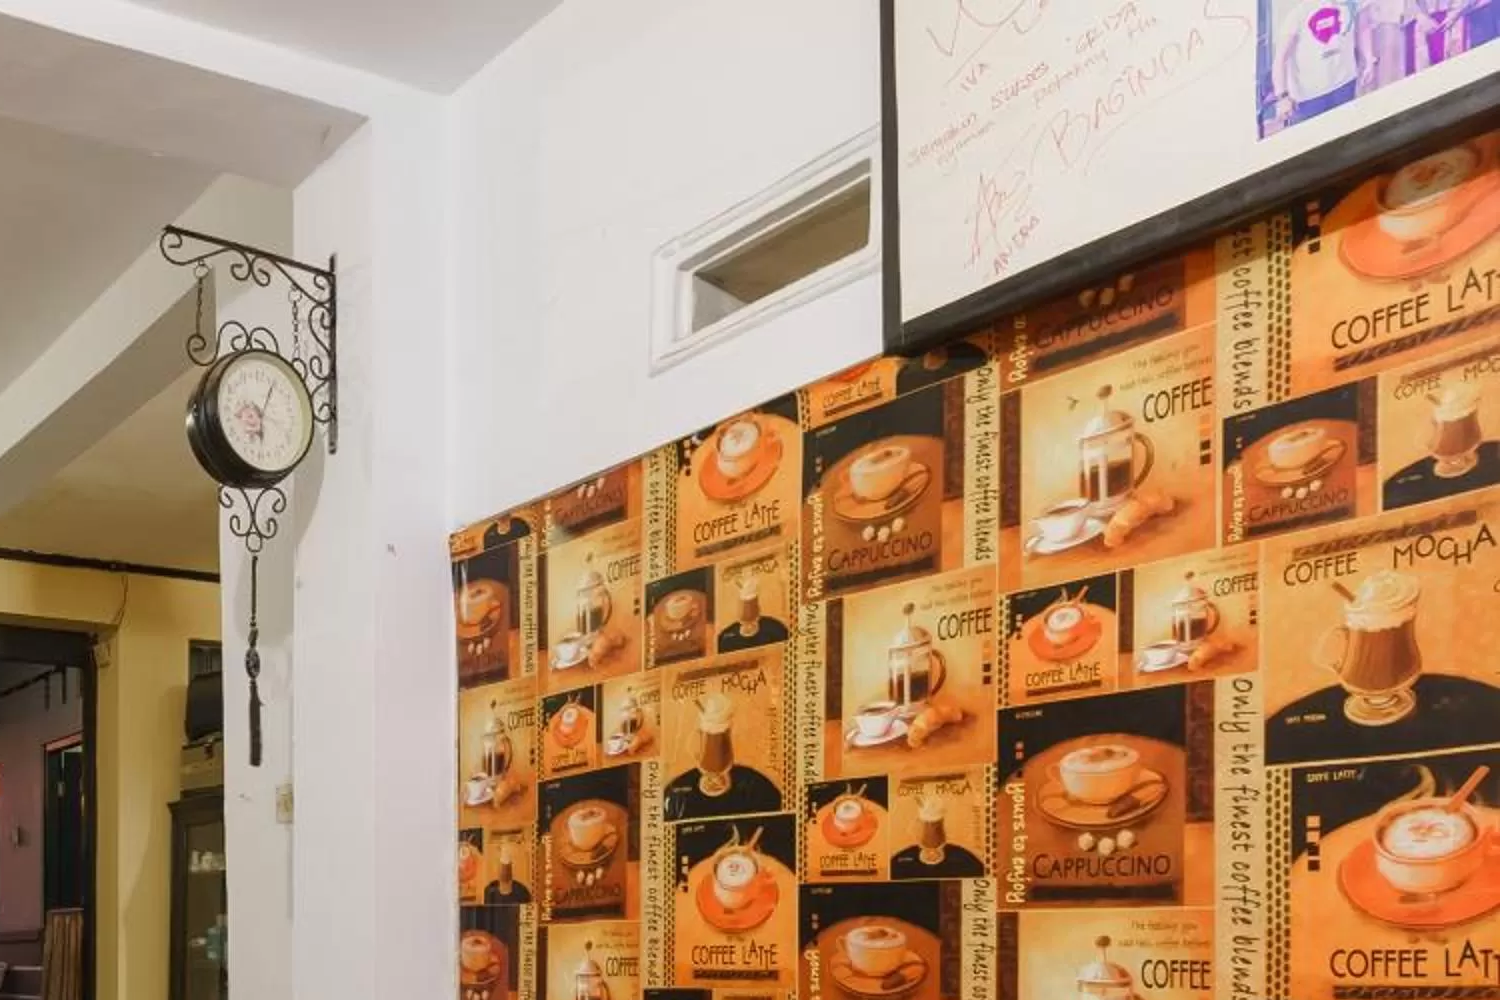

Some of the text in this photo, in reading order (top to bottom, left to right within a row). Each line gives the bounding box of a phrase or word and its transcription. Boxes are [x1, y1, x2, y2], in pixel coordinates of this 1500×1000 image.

[1224, 266, 1262, 332] coffee
[1331, 267, 1500, 350] COFFEE LAT
[1233, 337, 1262, 410] blends
[1461, 357, 1500, 382] MOC
[1143, 375, 1212, 422] COFFEE
[693, 499, 781, 543] COFFEE LATTE
[1249, 487, 1349, 522] CAPPUCCINO
[607, 553, 642, 583] COFFEE
[827, 531, 933, 573] CAPPUCCINO
[1283, 523, 1497, 586] COFFEE MOCHA
[1213, 572, 1258, 597] COFFEE
[937, 607, 993, 641] COFFEE
[721, 669, 767, 696] MOCHA
[1025, 662, 1101, 688] COFFEE LATTE
[1219, 678, 1260, 733] Only
[1231, 743, 1256, 776] the
[1221, 784, 1260, 853] finest
[1005, 782, 1031, 904] yours to enjoy
[819, 852, 877, 873] COFFEE LATTE
[1032, 853, 1171, 880] CAPPUCCINO
[964, 879, 992, 911] Only
[1222, 861, 1261, 926] coffee
[972, 918, 990, 938] the
[606, 956, 639, 977] COFFEE
[691, 938, 778, 972] COFFEE LATTE
[804, 949, 821, 991] yours
[967, 943, 995, 981] finest
[1329, 938, 1500, 985] COFFEE LATT
[1141, 959, 1212, 990] COFFEE
